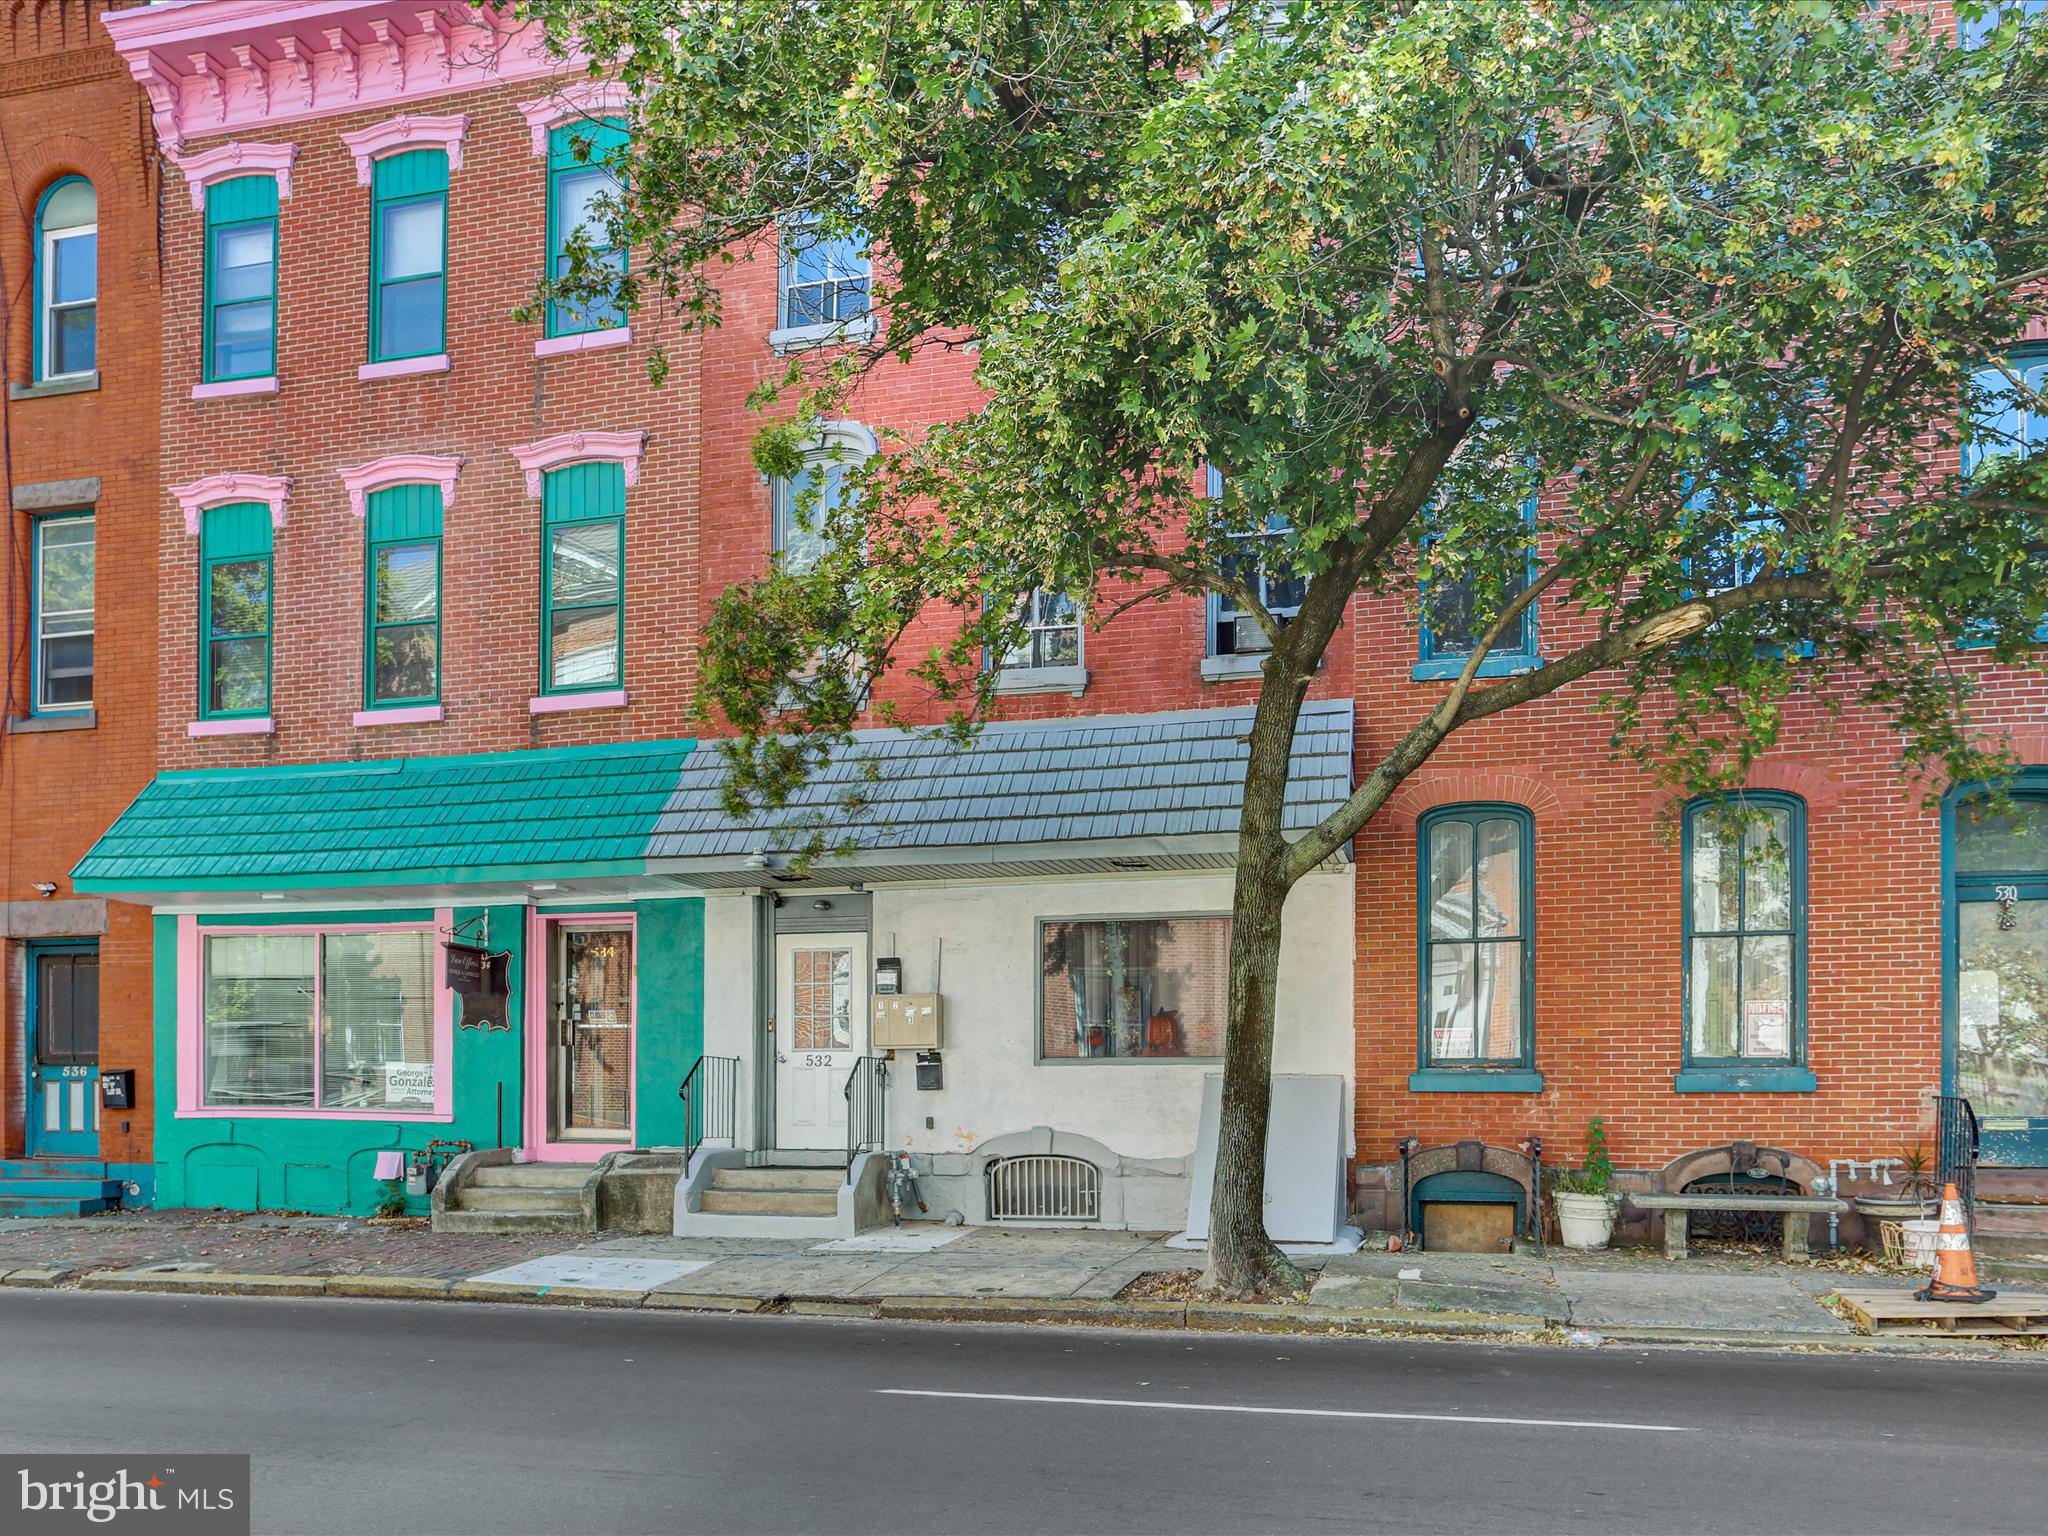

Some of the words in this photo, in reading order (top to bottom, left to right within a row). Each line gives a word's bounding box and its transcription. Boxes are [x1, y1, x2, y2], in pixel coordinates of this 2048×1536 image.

[1995, 885, 2018, 900] 530
[481, 961, 491, 970] 34
[806, 1054, 832, 1067] 532
[62, 1066, 88, 1077] 536
[396, 1069, 424, 1078] George
